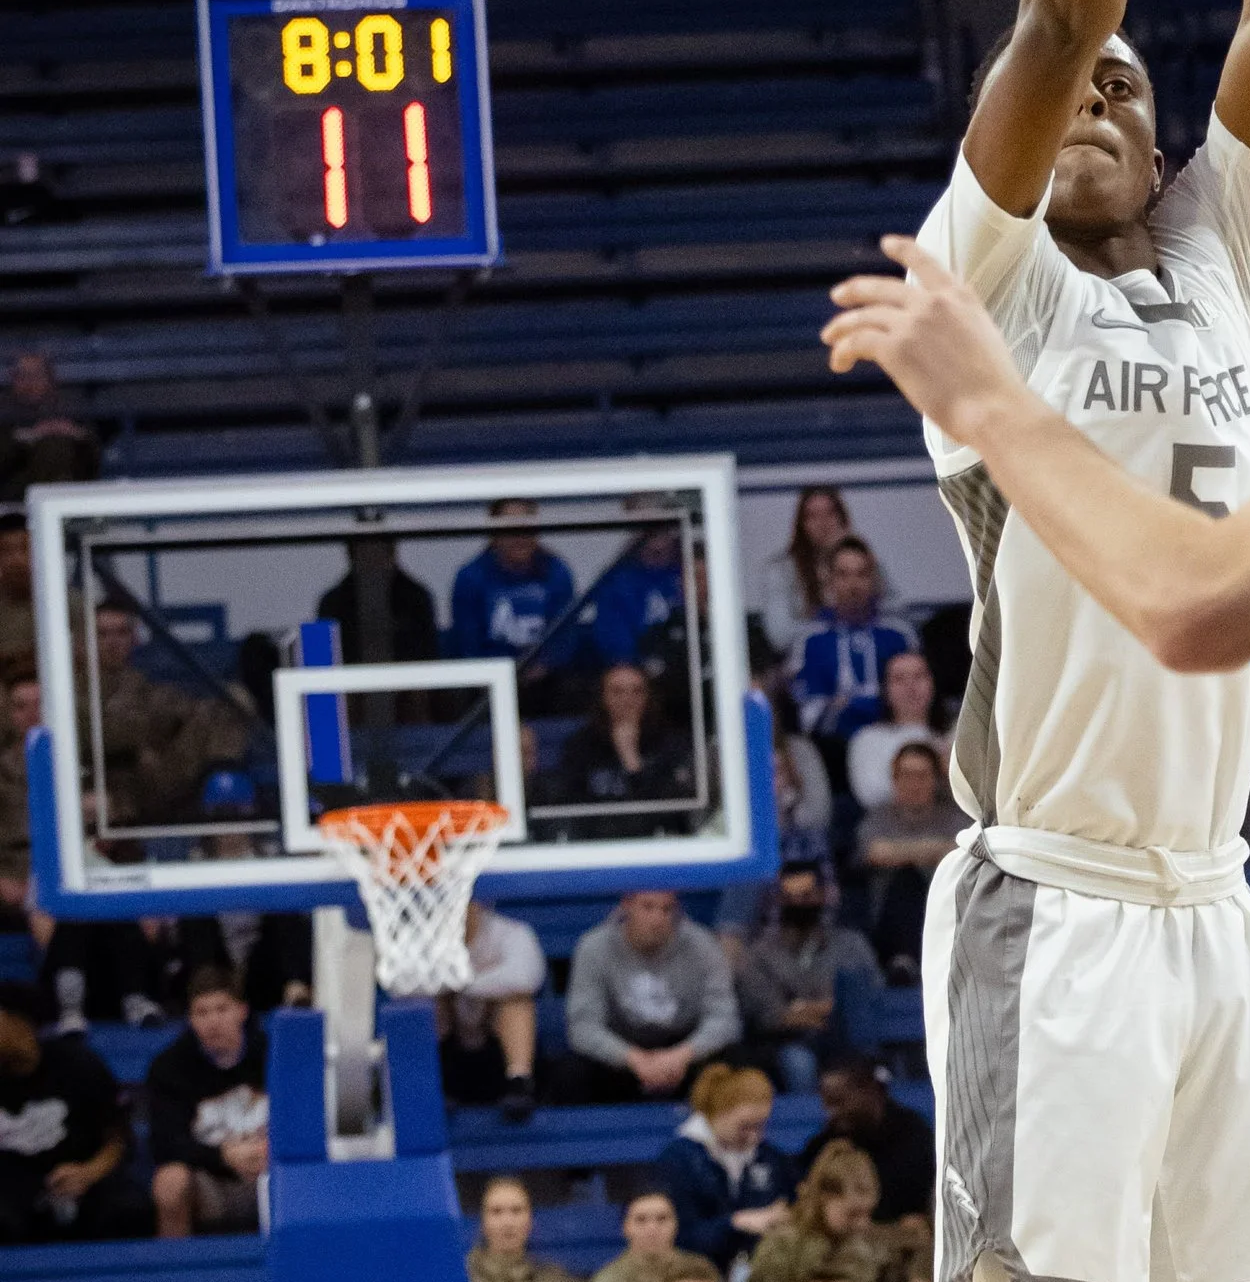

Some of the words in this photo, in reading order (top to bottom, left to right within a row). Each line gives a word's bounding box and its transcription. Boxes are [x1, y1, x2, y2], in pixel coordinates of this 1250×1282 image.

[281, 14, 452, 95] 8:01
[320, 100, 432, 230] 11
[1083, 359, 1168, 413] AIR
